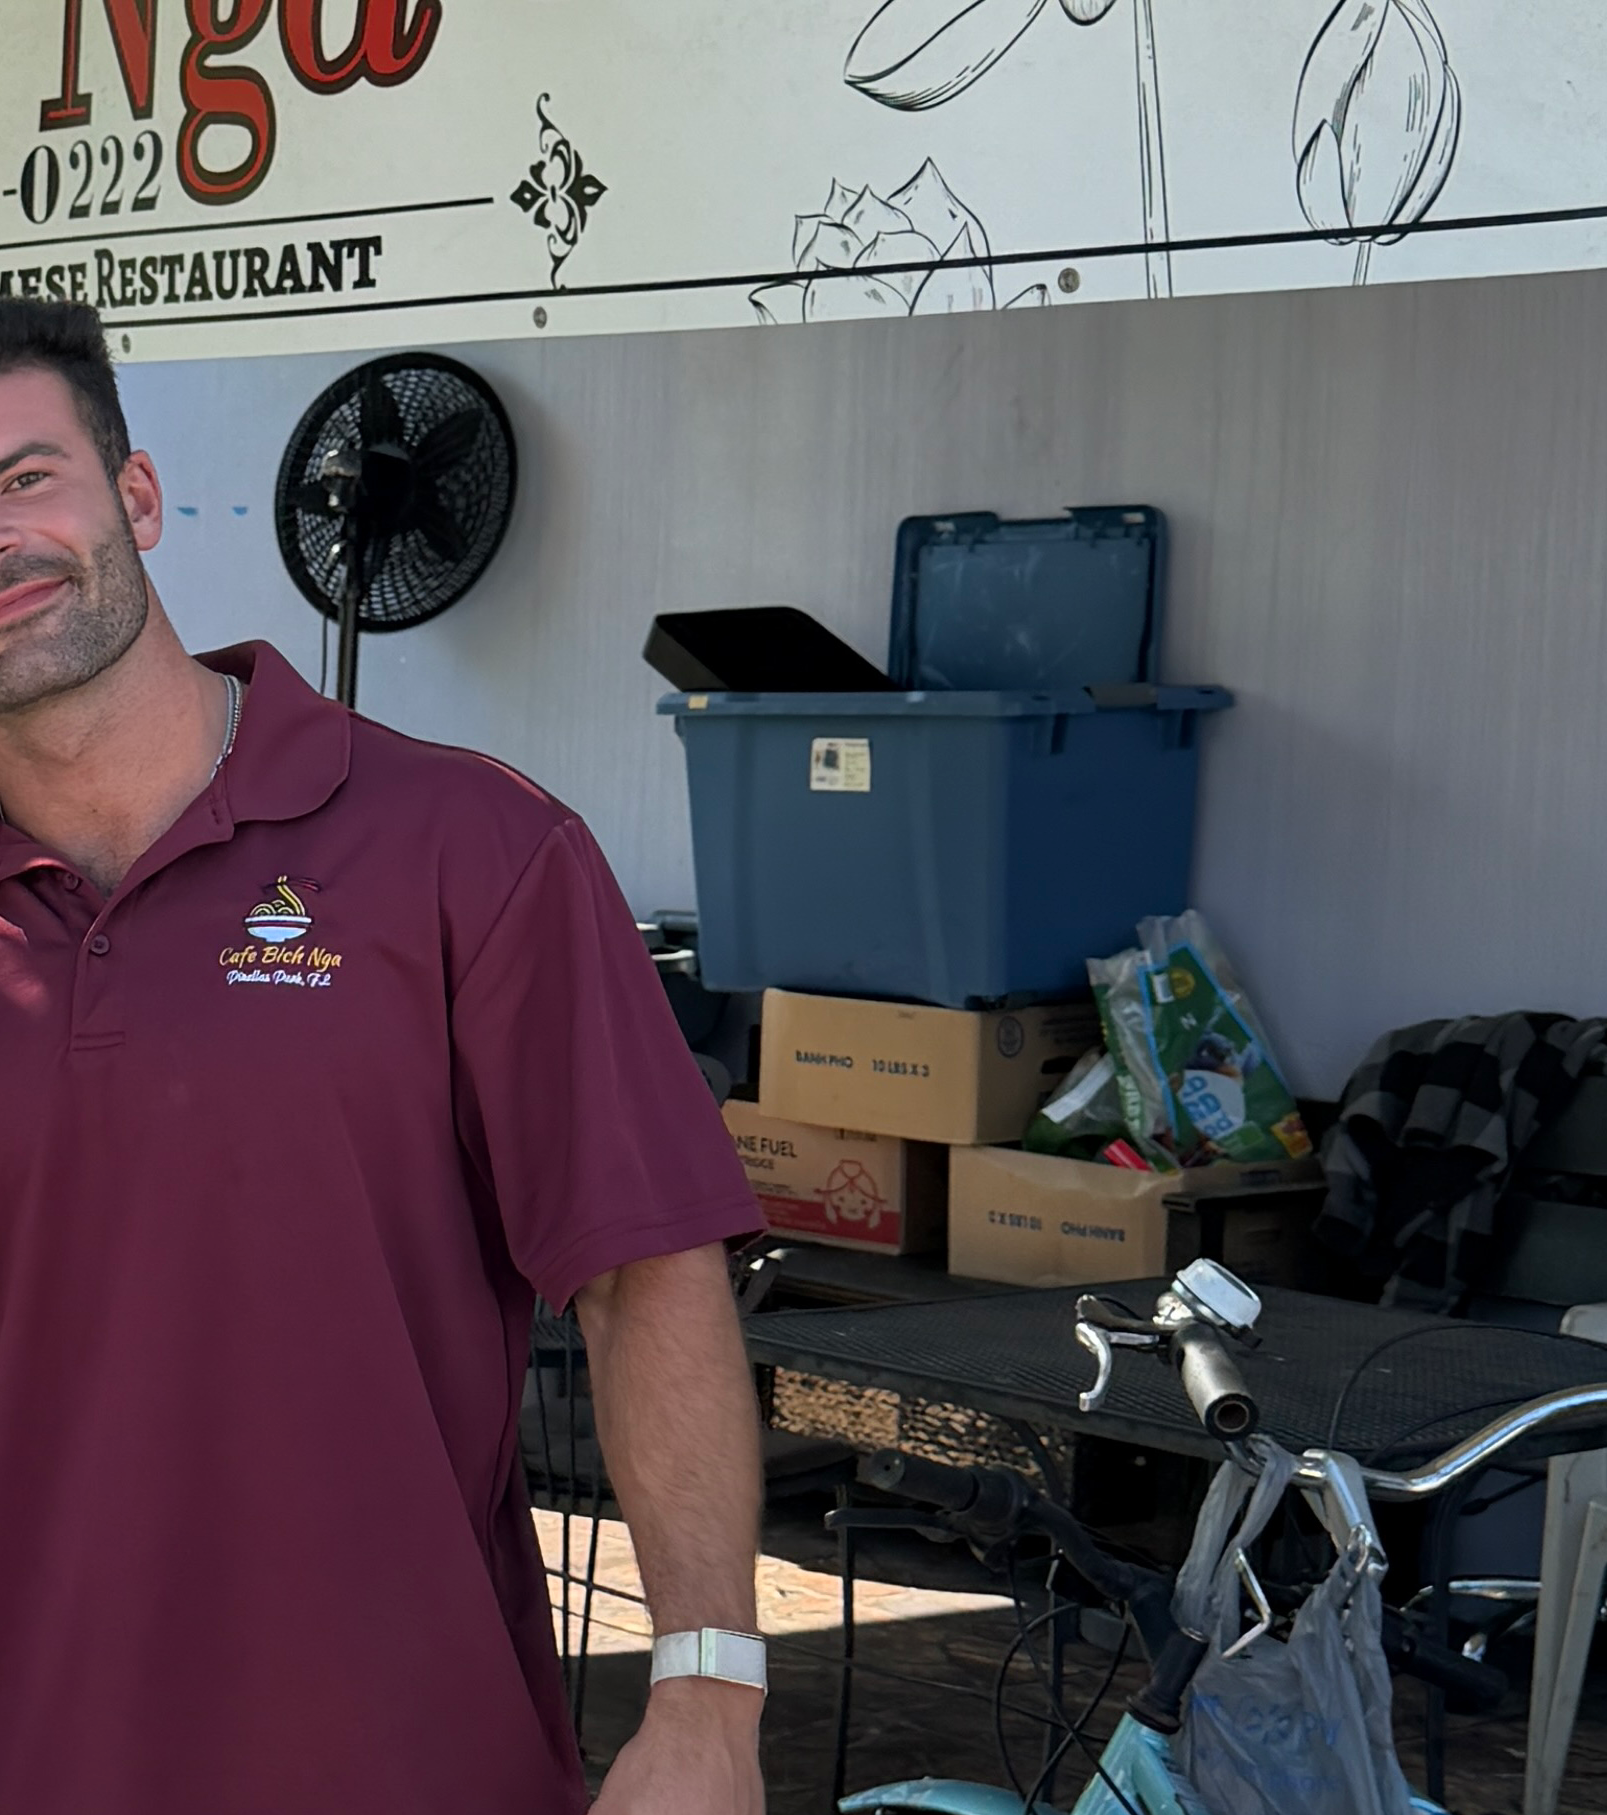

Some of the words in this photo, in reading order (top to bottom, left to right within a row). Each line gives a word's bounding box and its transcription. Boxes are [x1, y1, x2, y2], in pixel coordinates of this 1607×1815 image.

[38, 0, 443, 207] Nga
[219, 945, 258, 969] Cafe
[306, 947, 343, 973] Nga
[760, 1137, 798, 1158] FUEL
